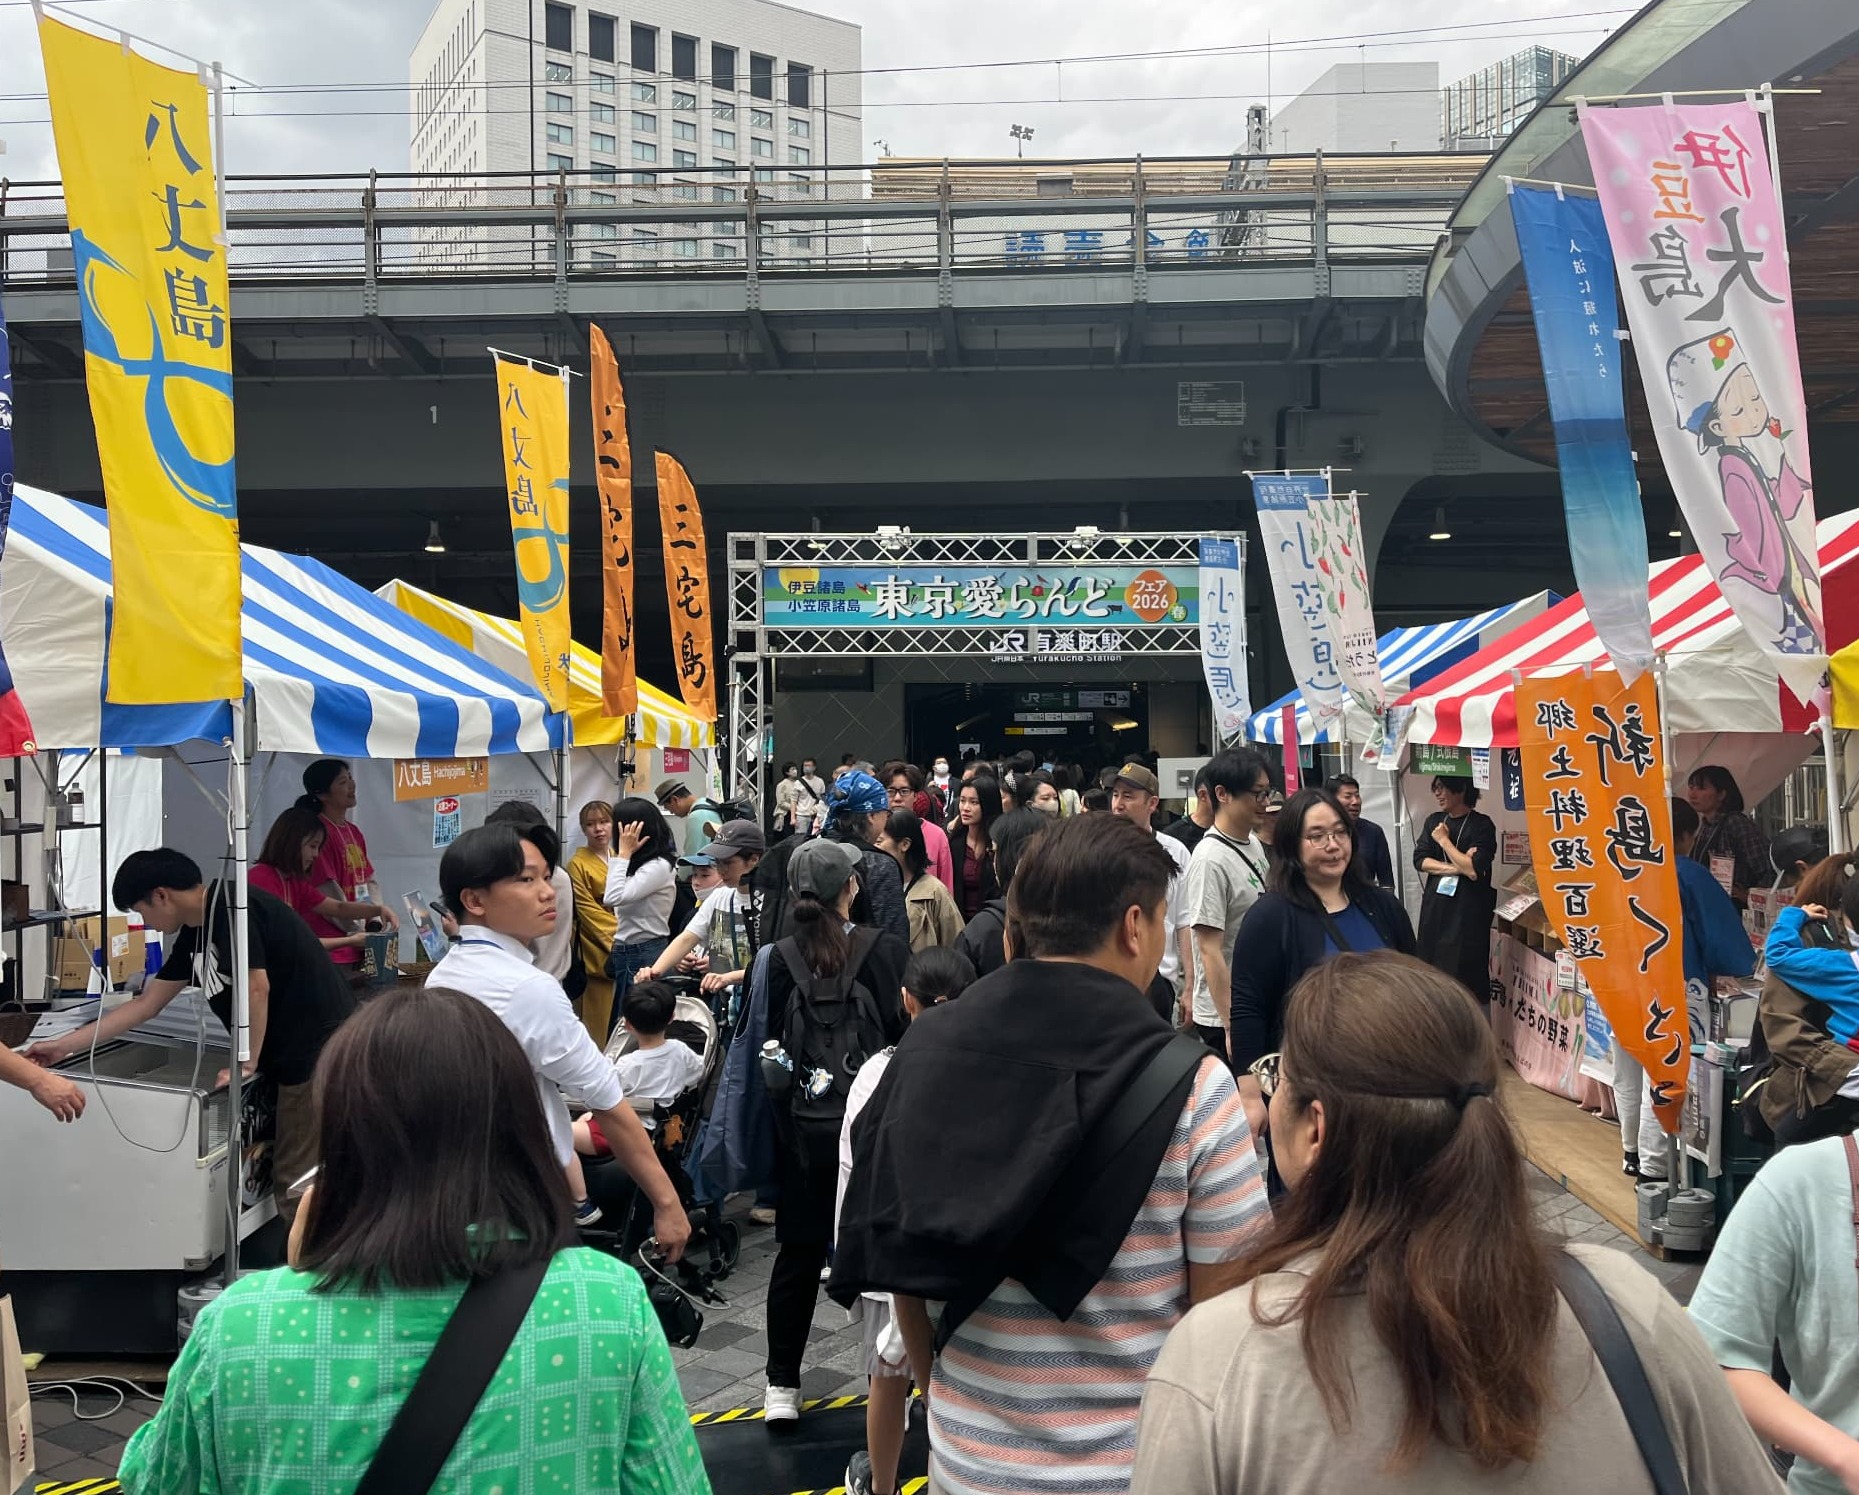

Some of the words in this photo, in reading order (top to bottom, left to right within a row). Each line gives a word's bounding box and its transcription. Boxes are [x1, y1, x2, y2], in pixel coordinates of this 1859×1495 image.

[145, 100, 225, 349] 八丈島
[429, 404, 437, 424] 1
[788, 580, 846, 595] 伊豆諸島
[1134, 579, 1168, 593] フェア
[669, 504, 707, 688] 三宅島
[869, 574, 1115, 620] 東京愛らんど
[1131, 594, 1169, 610] 2026
[788, 598, 861, 613] 小笠原諸島
[1172, 605, 1186, 620] 春
[990, 633, 1025, 652] JR
[1086, 654, 1122, 663] Station
[1022, 692, 1041, 703] JR
[398, 761, 432, 788] 八丈島
